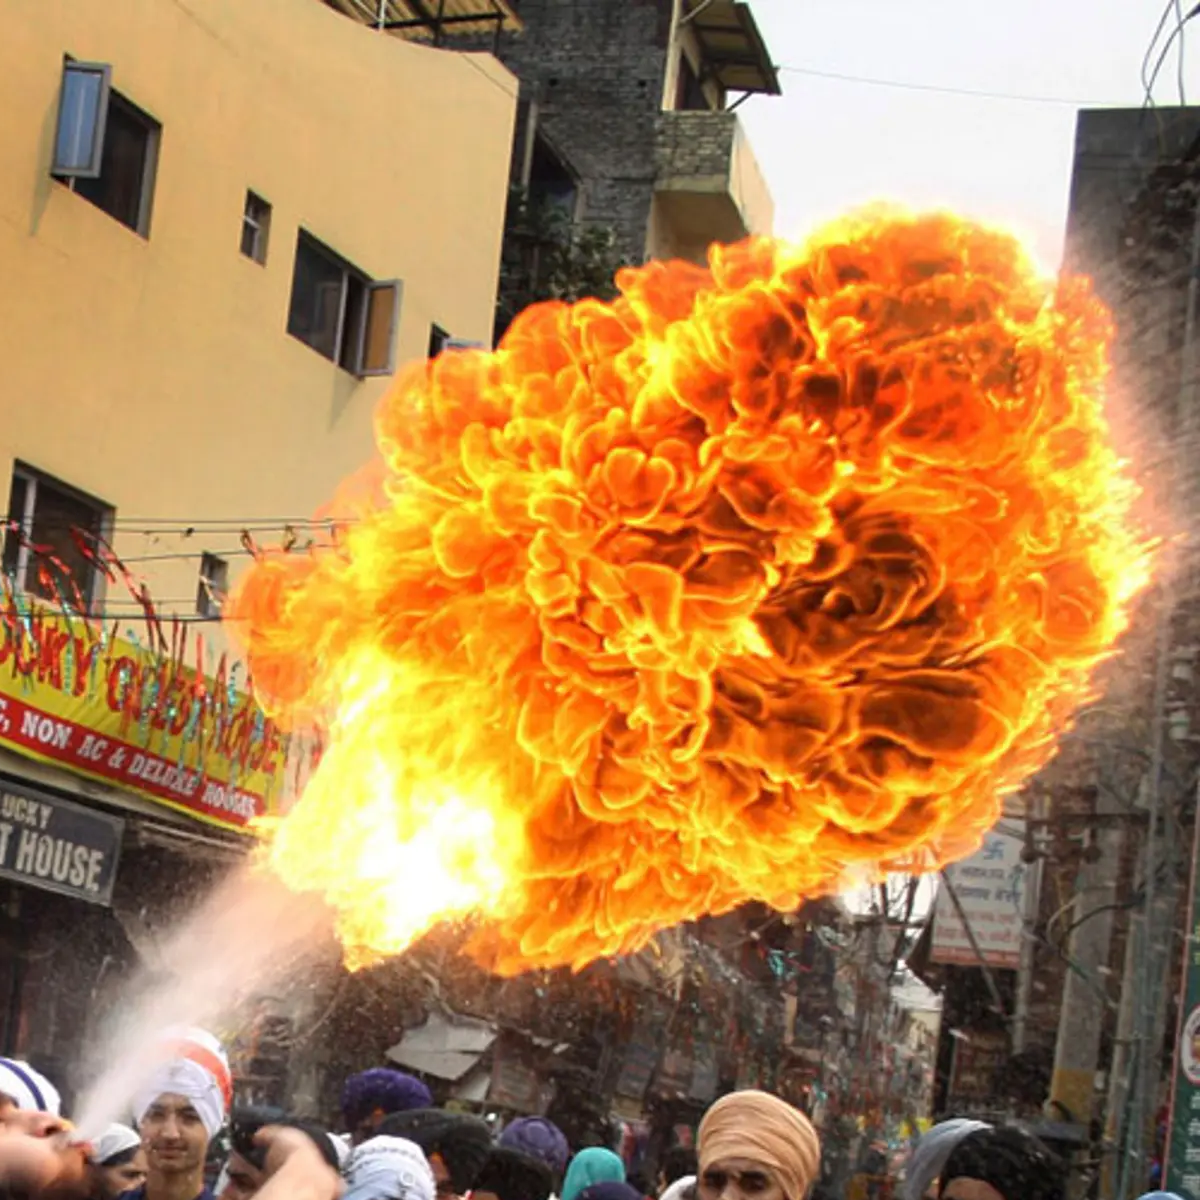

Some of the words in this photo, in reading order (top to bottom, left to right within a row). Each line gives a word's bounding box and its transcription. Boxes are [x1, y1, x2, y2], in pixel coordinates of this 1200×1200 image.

[20, 710, 73, 750] NON
[76, 734, 108, 761] AC
[108, 747, 127, 769] &
[129, 753, 201, 797] DELUXE
[14, 828, 104, 892] HOUSE
